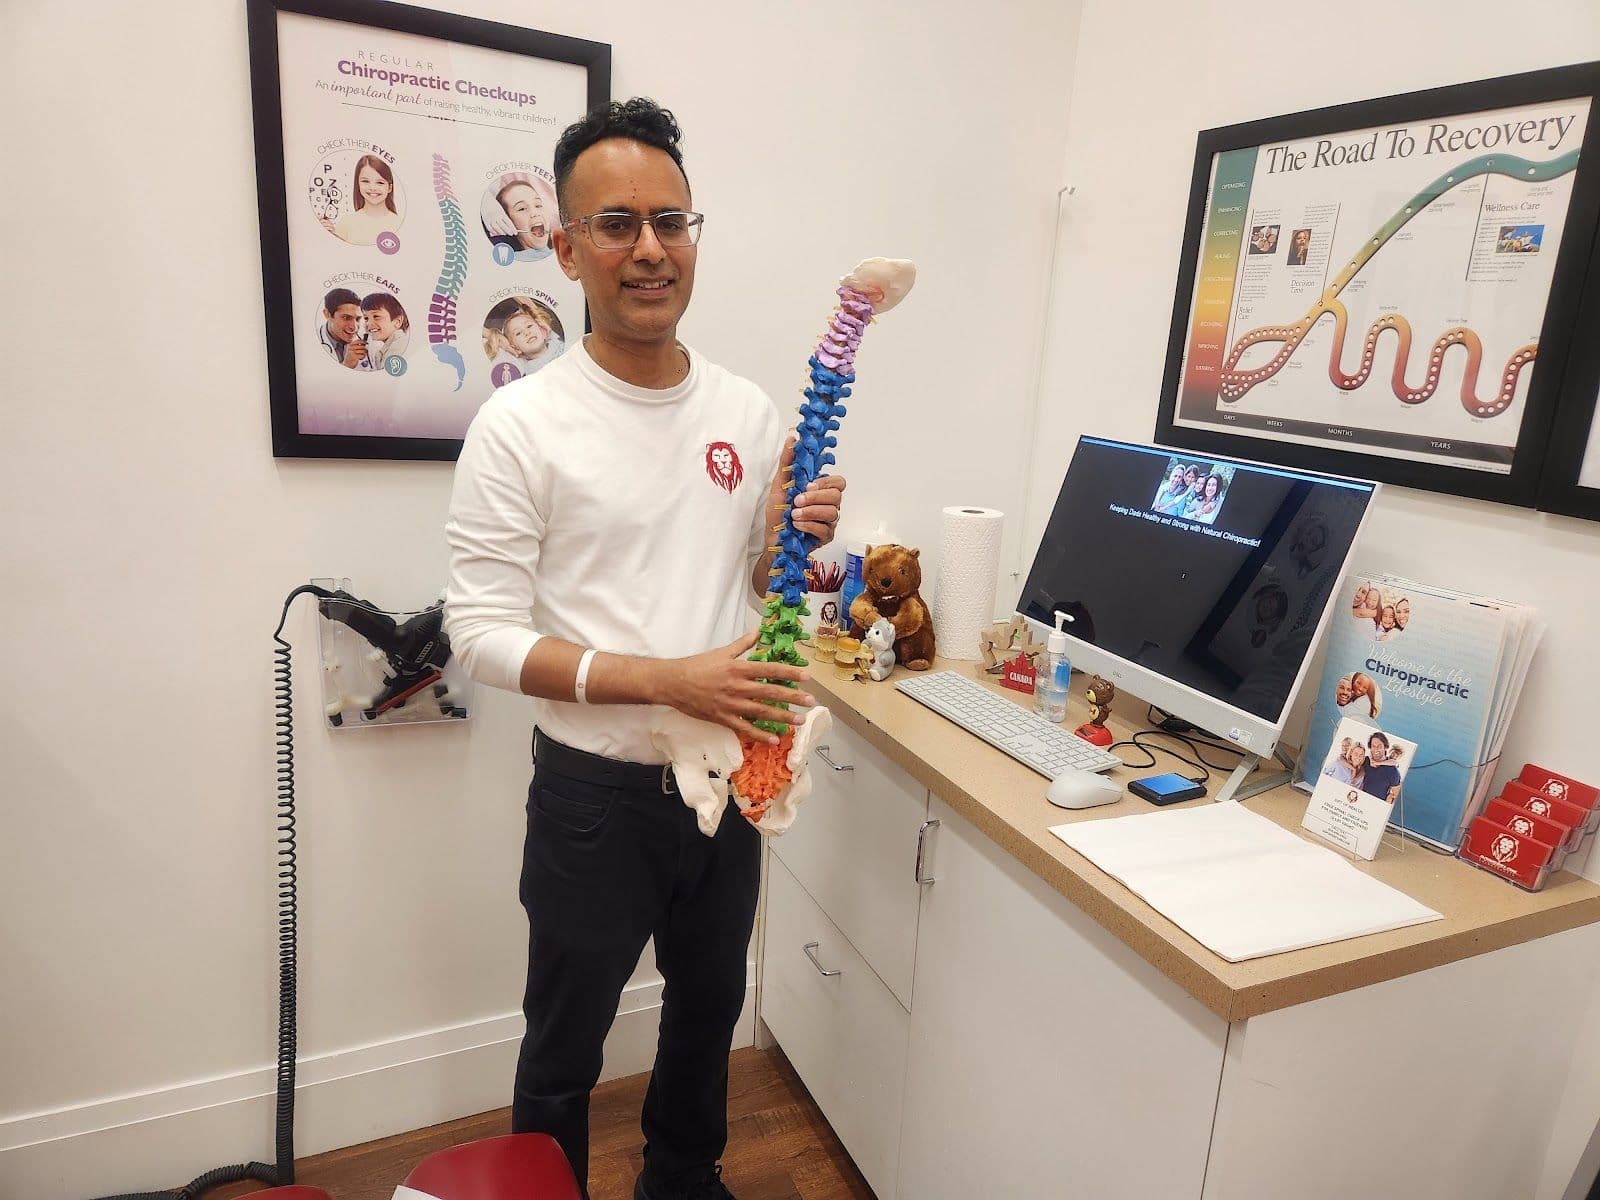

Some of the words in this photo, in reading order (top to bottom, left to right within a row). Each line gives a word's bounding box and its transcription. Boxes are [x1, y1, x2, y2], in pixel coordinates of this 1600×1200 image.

[358, 50, 434, 72] REGULAR
[337, 60, 450, 91] Chiropractic
[455, 79, 537, 107] Checkups
[315, 80, 329, 90] An
[330, 81, 393, 101] important
[395, 93, 422, 105] part
[423, 98, 433, 106] of
[434, 98, 460, 113] raising
[461, 102, 492, 117] healthy,
[493, 107, 520, 120] vibrant
[522, 110, 557, 126] children!
[317, 138, 345, 154] CHECK
[345, 139, 371, 150] THEIR
[371, 144, 396, 164] EYES
[1266, 145, 1307, 174] The
[1311, 132, 1379, 169] Road
[1385, 128, 1415, 160] To
[1423, 114, 1577, 155] Recovery
[324, 164, 332, 174] P
[1484, 203, 1518, 213] Wellness
[1520, 201, 1541, 211] Care
[375, 276, 401, 295] EARS
[534, 289, 560, 308] SPINE
[1327, 427, 1353, 437] MONTHS
[1430, 441, 1451, 450] YEARS
[1109, 503, 1129, 515] Keeping
[1142, 511, 1161, 523] Healthy
[1160, 517, 1172, 525] and
[1171, 519, 1190, 531] Strong
[1190, 524, 1201, 532] with
[1201, 526, 1222, 538] Natural
[1222, 531, 1261, 547] Chiropractic!
[1367, 640, 1425, 673] Welcome
[1429, 663, 1441, 678] to
[1446, 667, 1473, 687] the
[1009, 671, 1033, 686] CANADA
[1365, 658, 1469, 699] Chiropractic
[1382, 676, 1444, 706] Lifestyle
